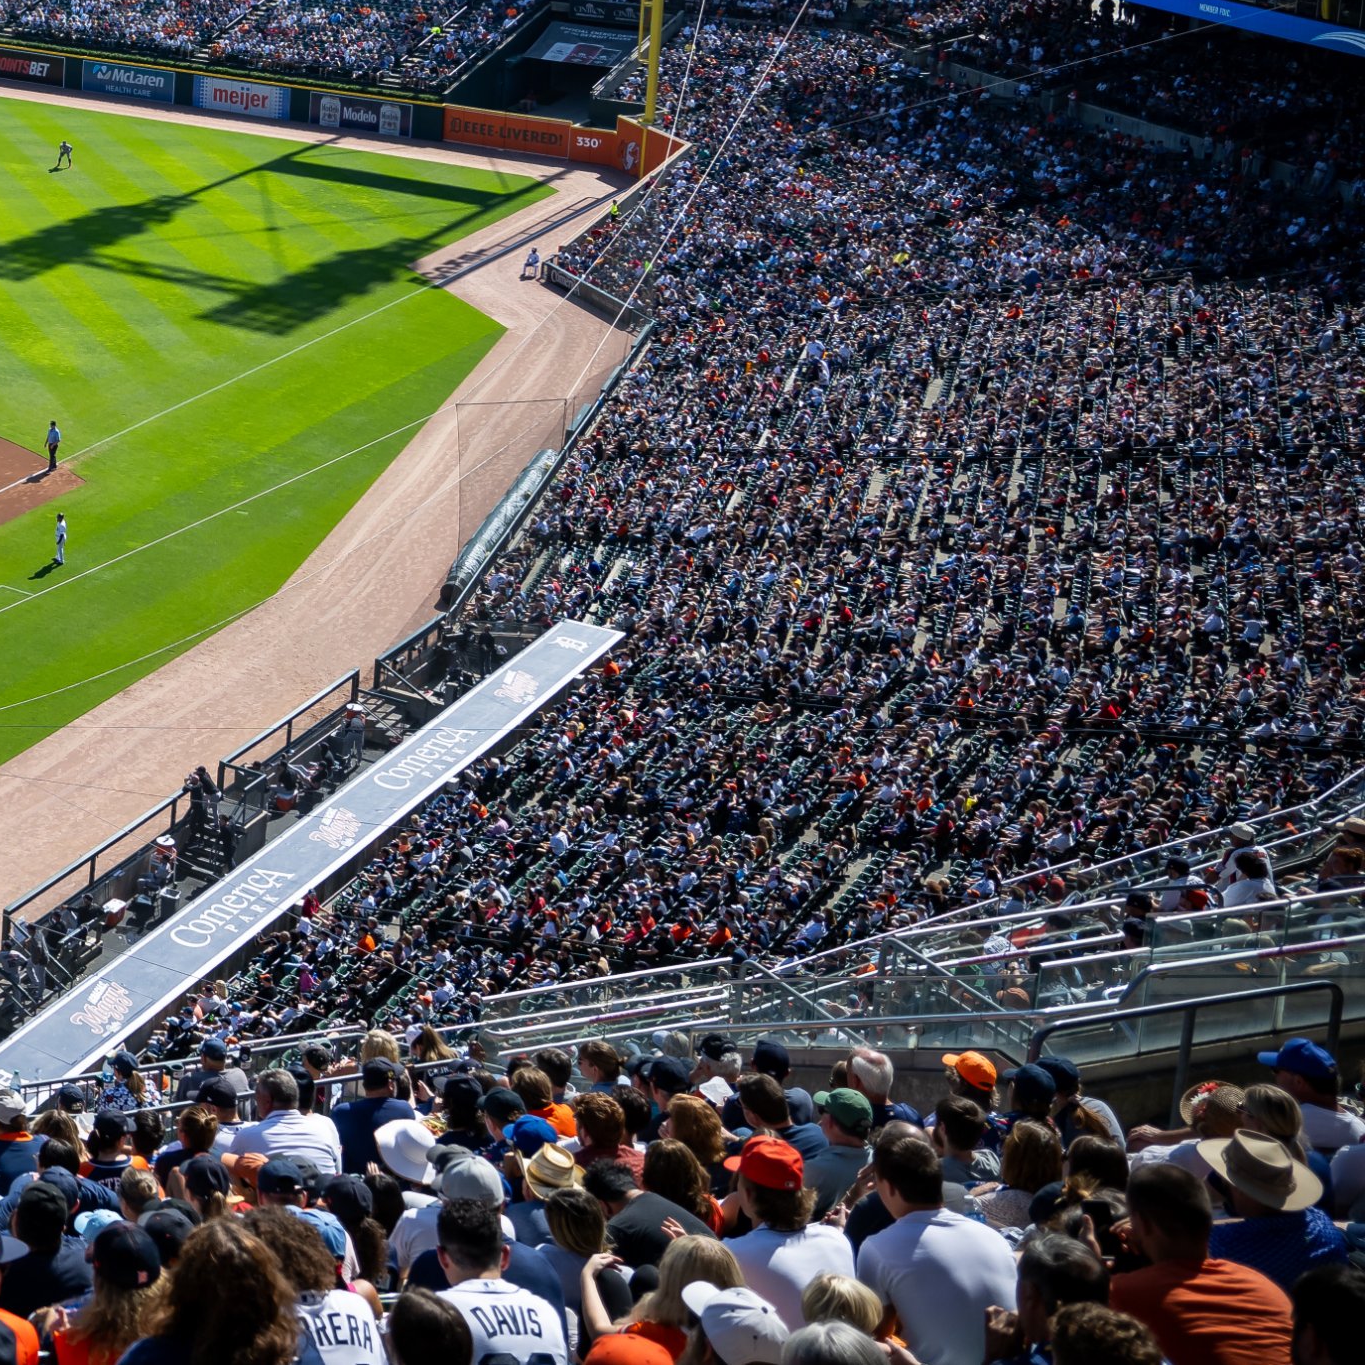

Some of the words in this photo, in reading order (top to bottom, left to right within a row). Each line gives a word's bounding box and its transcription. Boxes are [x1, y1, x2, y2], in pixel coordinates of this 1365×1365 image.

[112, 68, 165, 90] McLaren
[105, 84, 133, 94] HEALTH
[135, 88, 152, 98] CARE
[213, 82, 270, 111] meijer
[343, 106, 378, 125] Modelo
[576, 136, 603, 150] 330'
[421, 742, 474, 780] PARK
[471, 1304, 544, 1339] DAVIS
